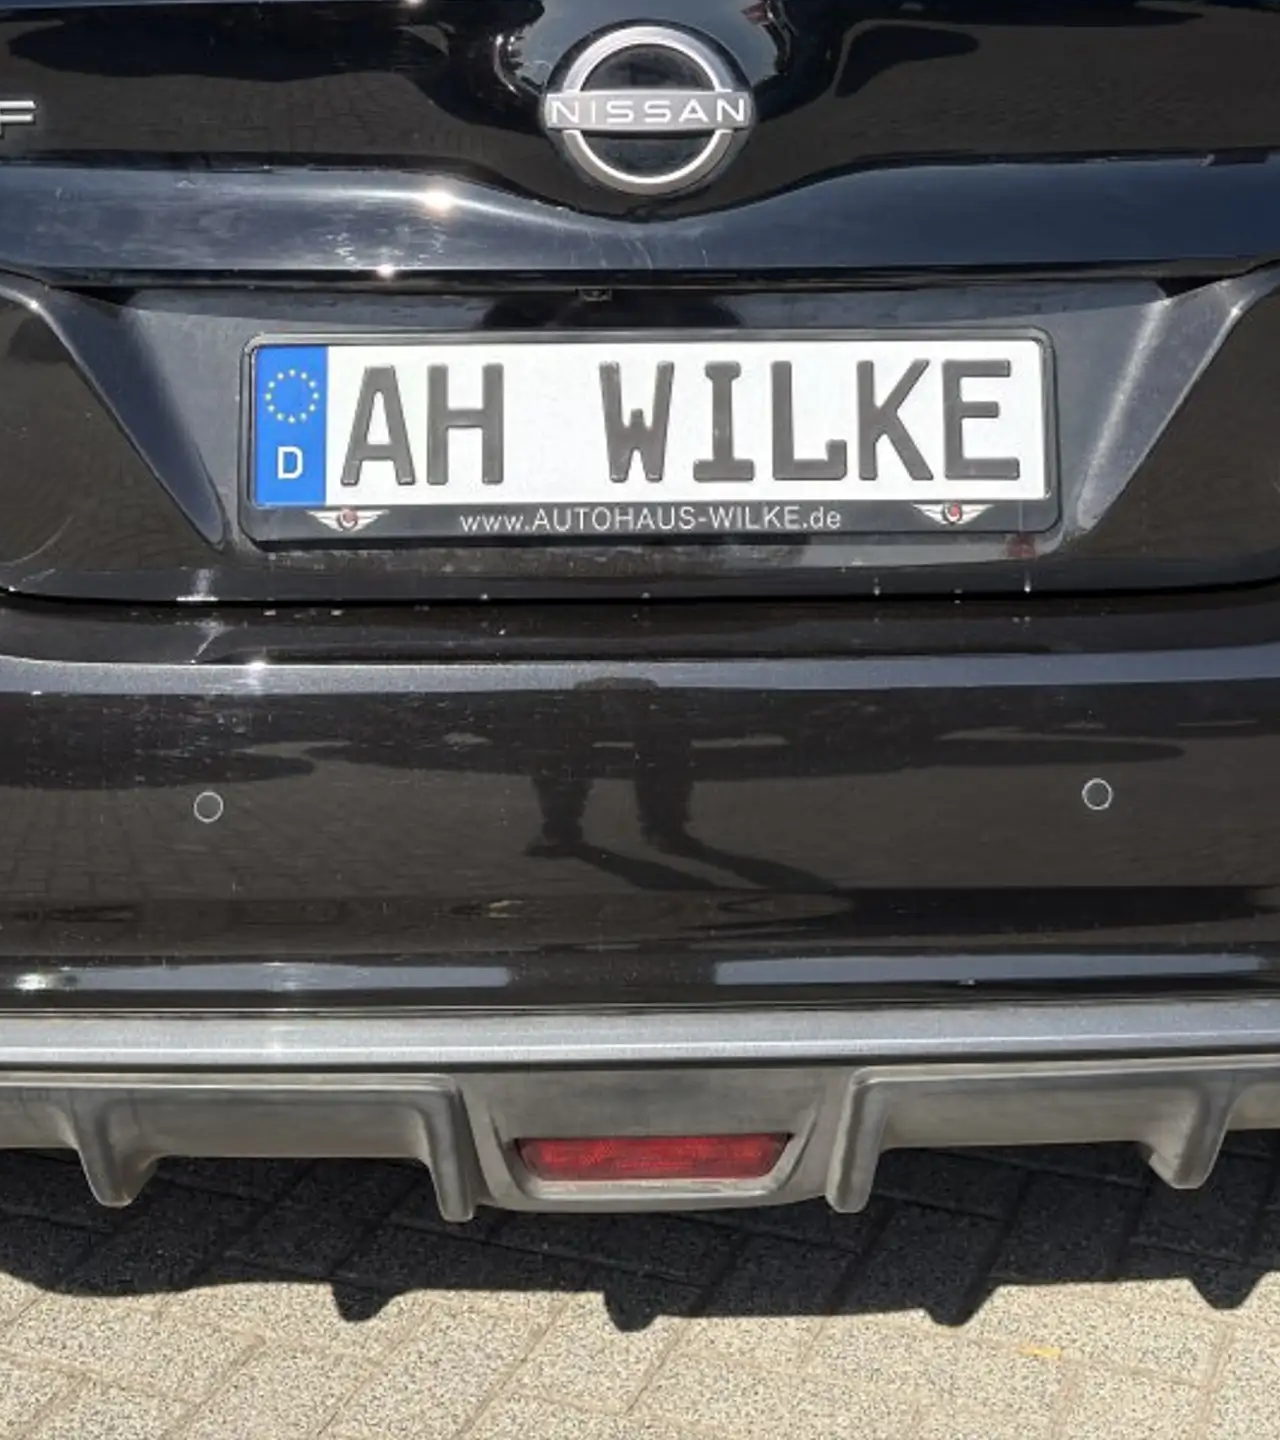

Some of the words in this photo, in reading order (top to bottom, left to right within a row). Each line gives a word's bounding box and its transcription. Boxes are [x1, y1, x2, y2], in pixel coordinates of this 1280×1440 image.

[551, 98, 745, 124] NISSAN
[340, 363, 504, 486] AH
[599, 359, 1020, 482] WILKE
[277, 446, 304, 479] D
[460, 505, 842, 533] www.AUTOHAUS-WILKE.de
